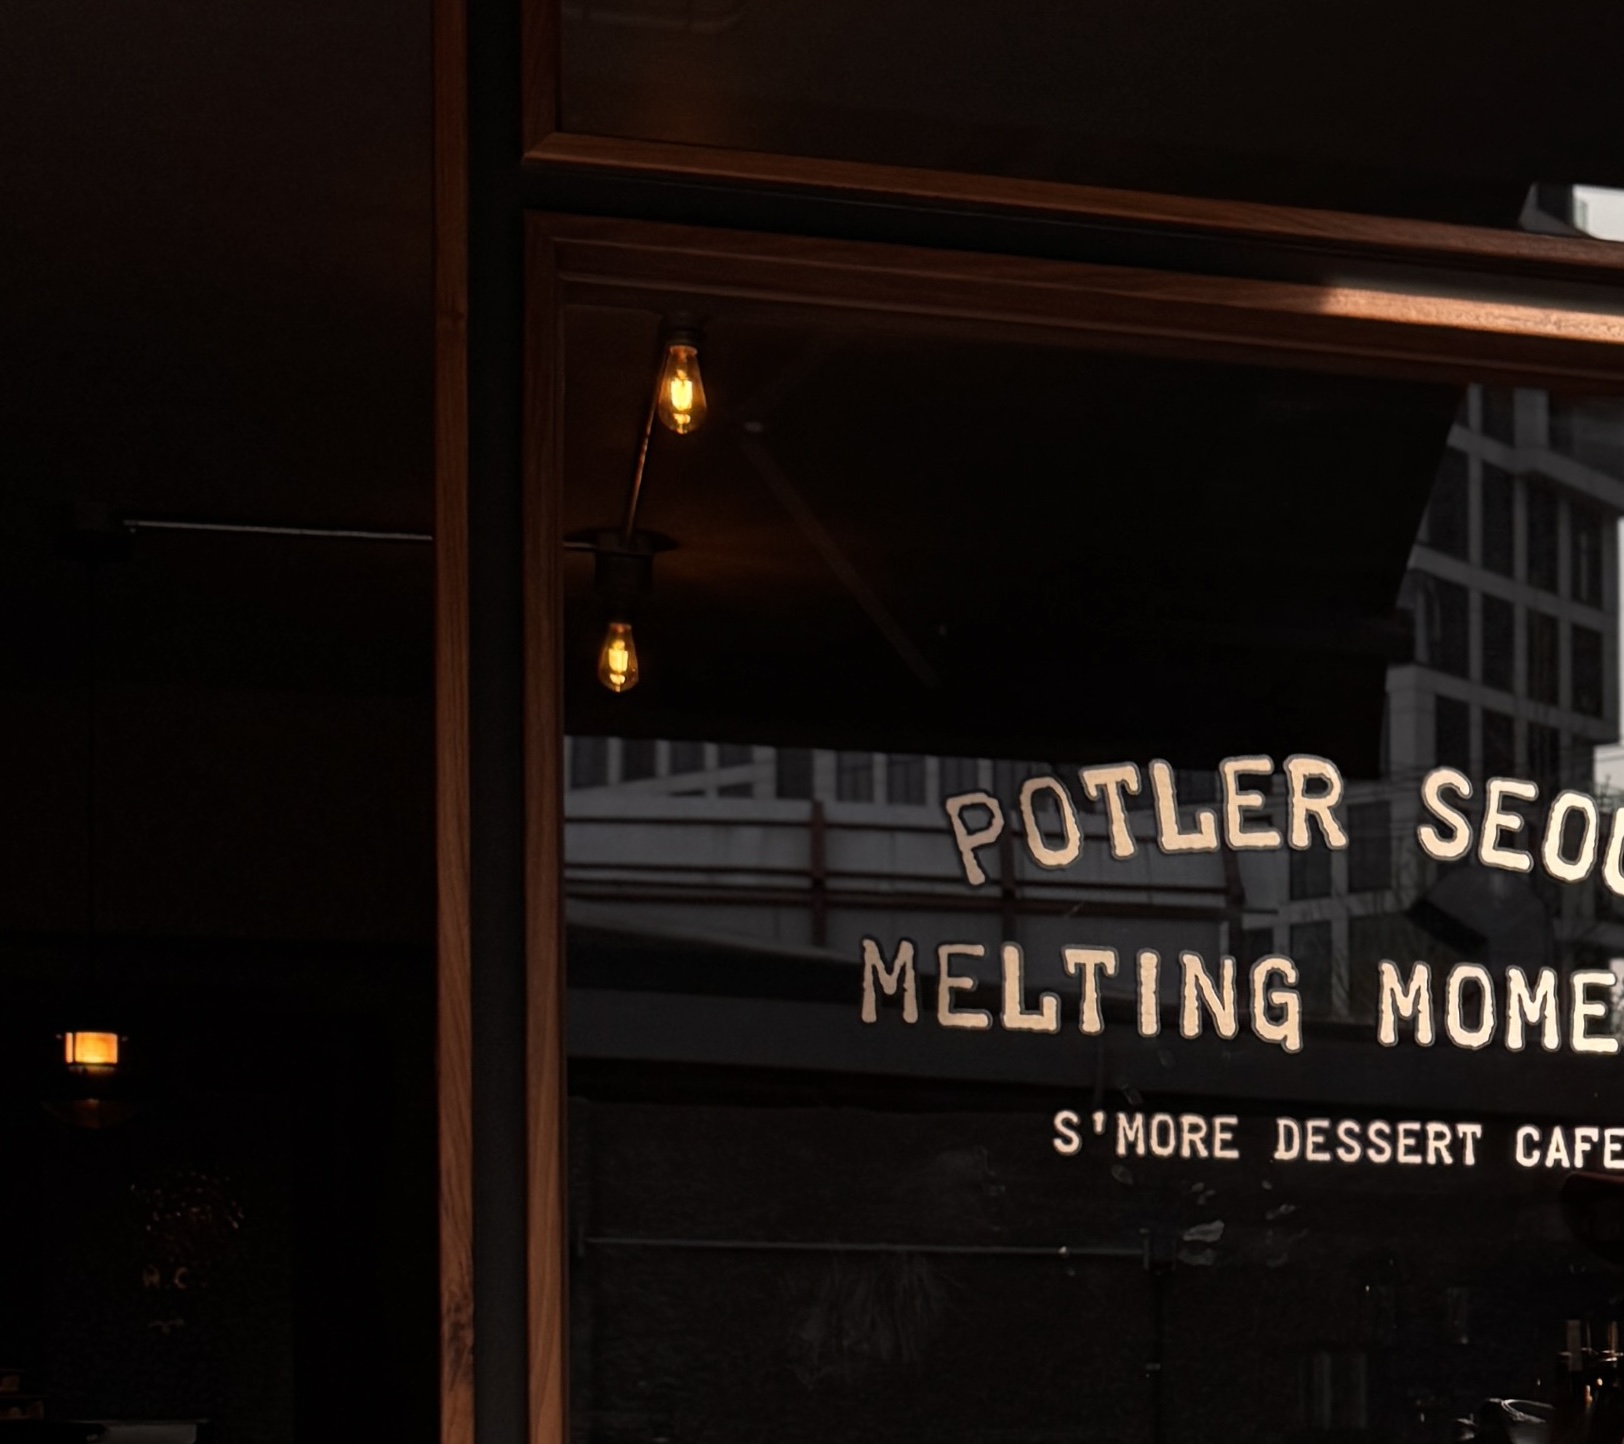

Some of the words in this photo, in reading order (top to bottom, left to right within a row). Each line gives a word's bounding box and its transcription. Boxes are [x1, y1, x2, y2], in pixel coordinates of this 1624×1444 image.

[945, 754, 1348, 886] POTLER
[861, 938, 1302, 1052] MELTING
[1053, 1110, 1240, 1159] S'MORE
[1273, 1117, 1483, 1166] DESSERT
